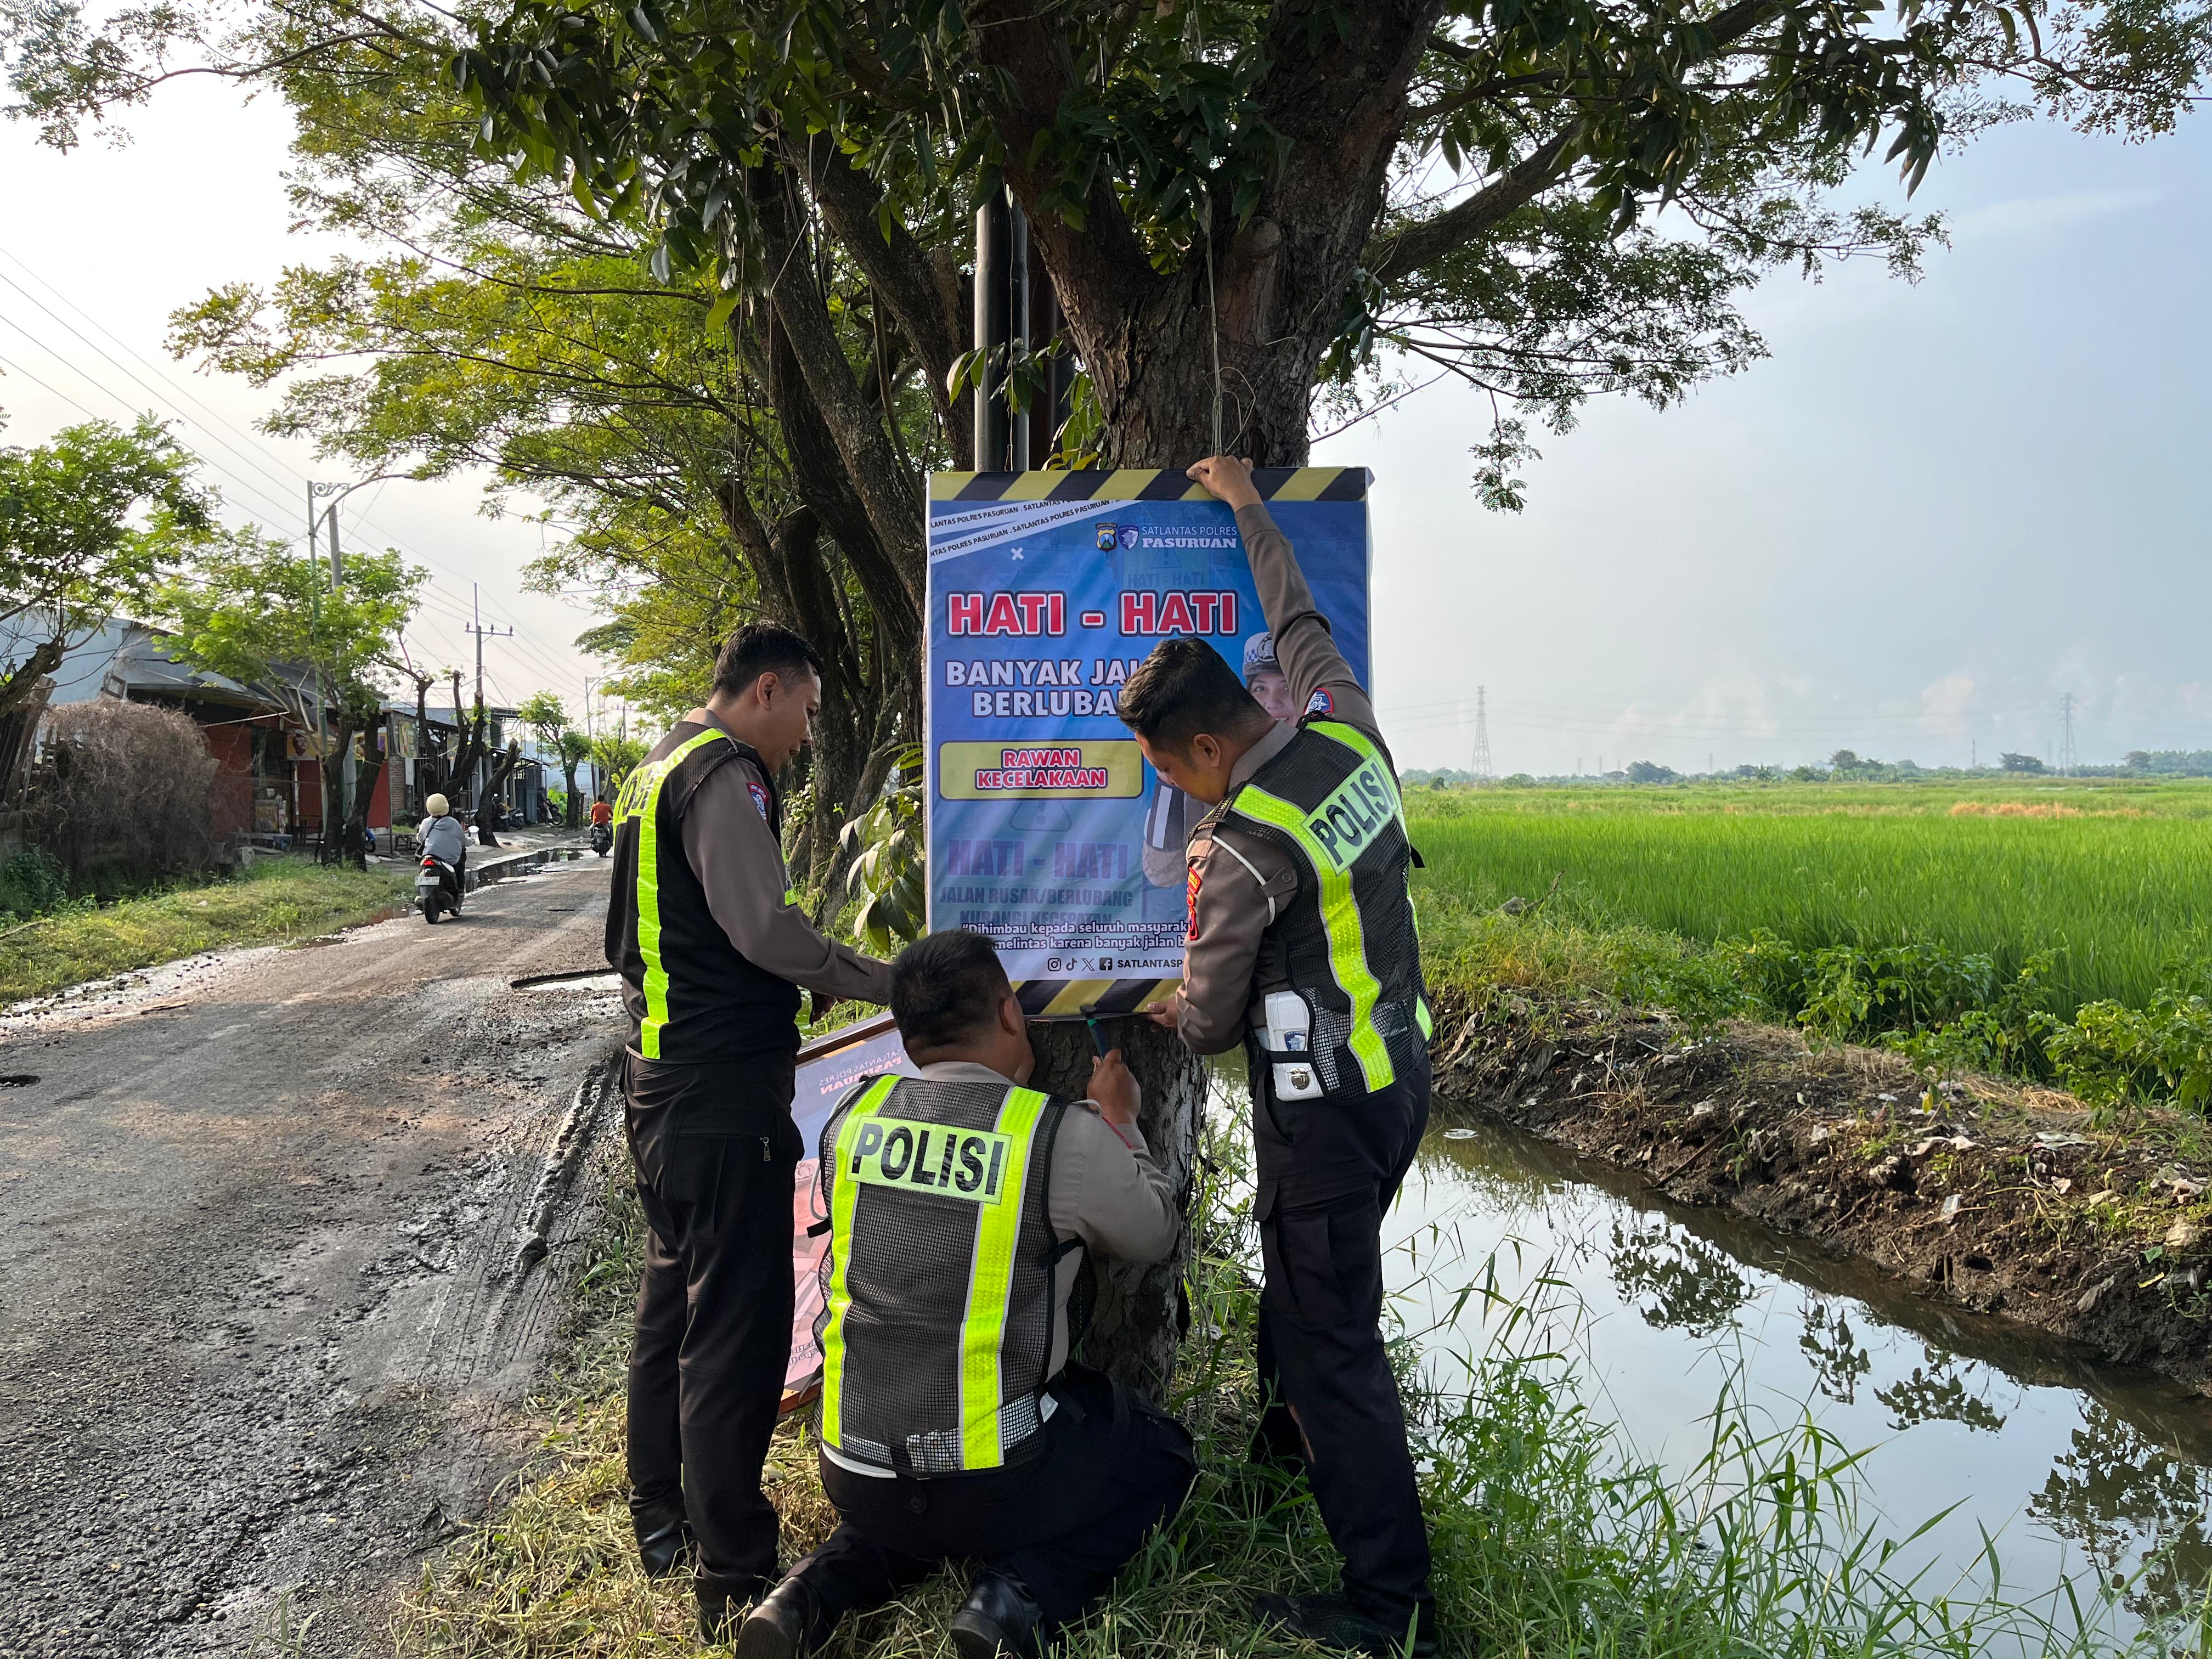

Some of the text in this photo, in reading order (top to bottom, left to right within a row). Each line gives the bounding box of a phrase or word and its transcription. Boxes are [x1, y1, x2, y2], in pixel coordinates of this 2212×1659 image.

[930, 518, 956, 528] LANTAS
[957, 513, 983, 523] POLRES
[984, 507, 1019, 518] PASURUAN
[1024, 500, 1061, 511] SATLANTAS
[930, 547, 947, 557] NTAS
[948, 540, 973, 552] POLRES
[973, 529, 1008, 544] PASURUAN
[1012, 517, 1049, 532] SATLANTAS
[1051, 509, 1075, 521] POLRES
[1075, 500, 1110, 514] PASURUAN
[1142, 526, 1197, 535] SATLANTAS
[1200, 526, 1237, 535] POLRES
[1142, 538, 1237, 548] PASURUAN
[948, 592, 1237, 635] HATI - HATI
[946, 660, 1081, 685] BANYAK
[973, 691, 1122, 715] BERLUBA
[1004, 749, 1079, 768] RAWAN
[977, 770, 1106, 788] KECELAKAAN
[1310, 763, 1395, 866] POLISI
[948, 840, 1025, 877] HATI
[1054, 842, 1128, 879] HATI
[940, 887, 1133, 907] JALAN RUSAK/BERLUBANG
[1031, 922, 1076, 936] kepada
[1079, 921, 1124, 933] seluruh
[1128, 921, 1189, 934] masyarak
[995, 937, 1047, 949] melintas
[1050, 937, 1092, 949] karena
[1095, 936, 1142, 951] banyak
[1143, 935, 1175, 951] jalan
[1117, 960, 1183, 968] SATLANTASP
[851, 1123, 1004, 1195] POLISI
